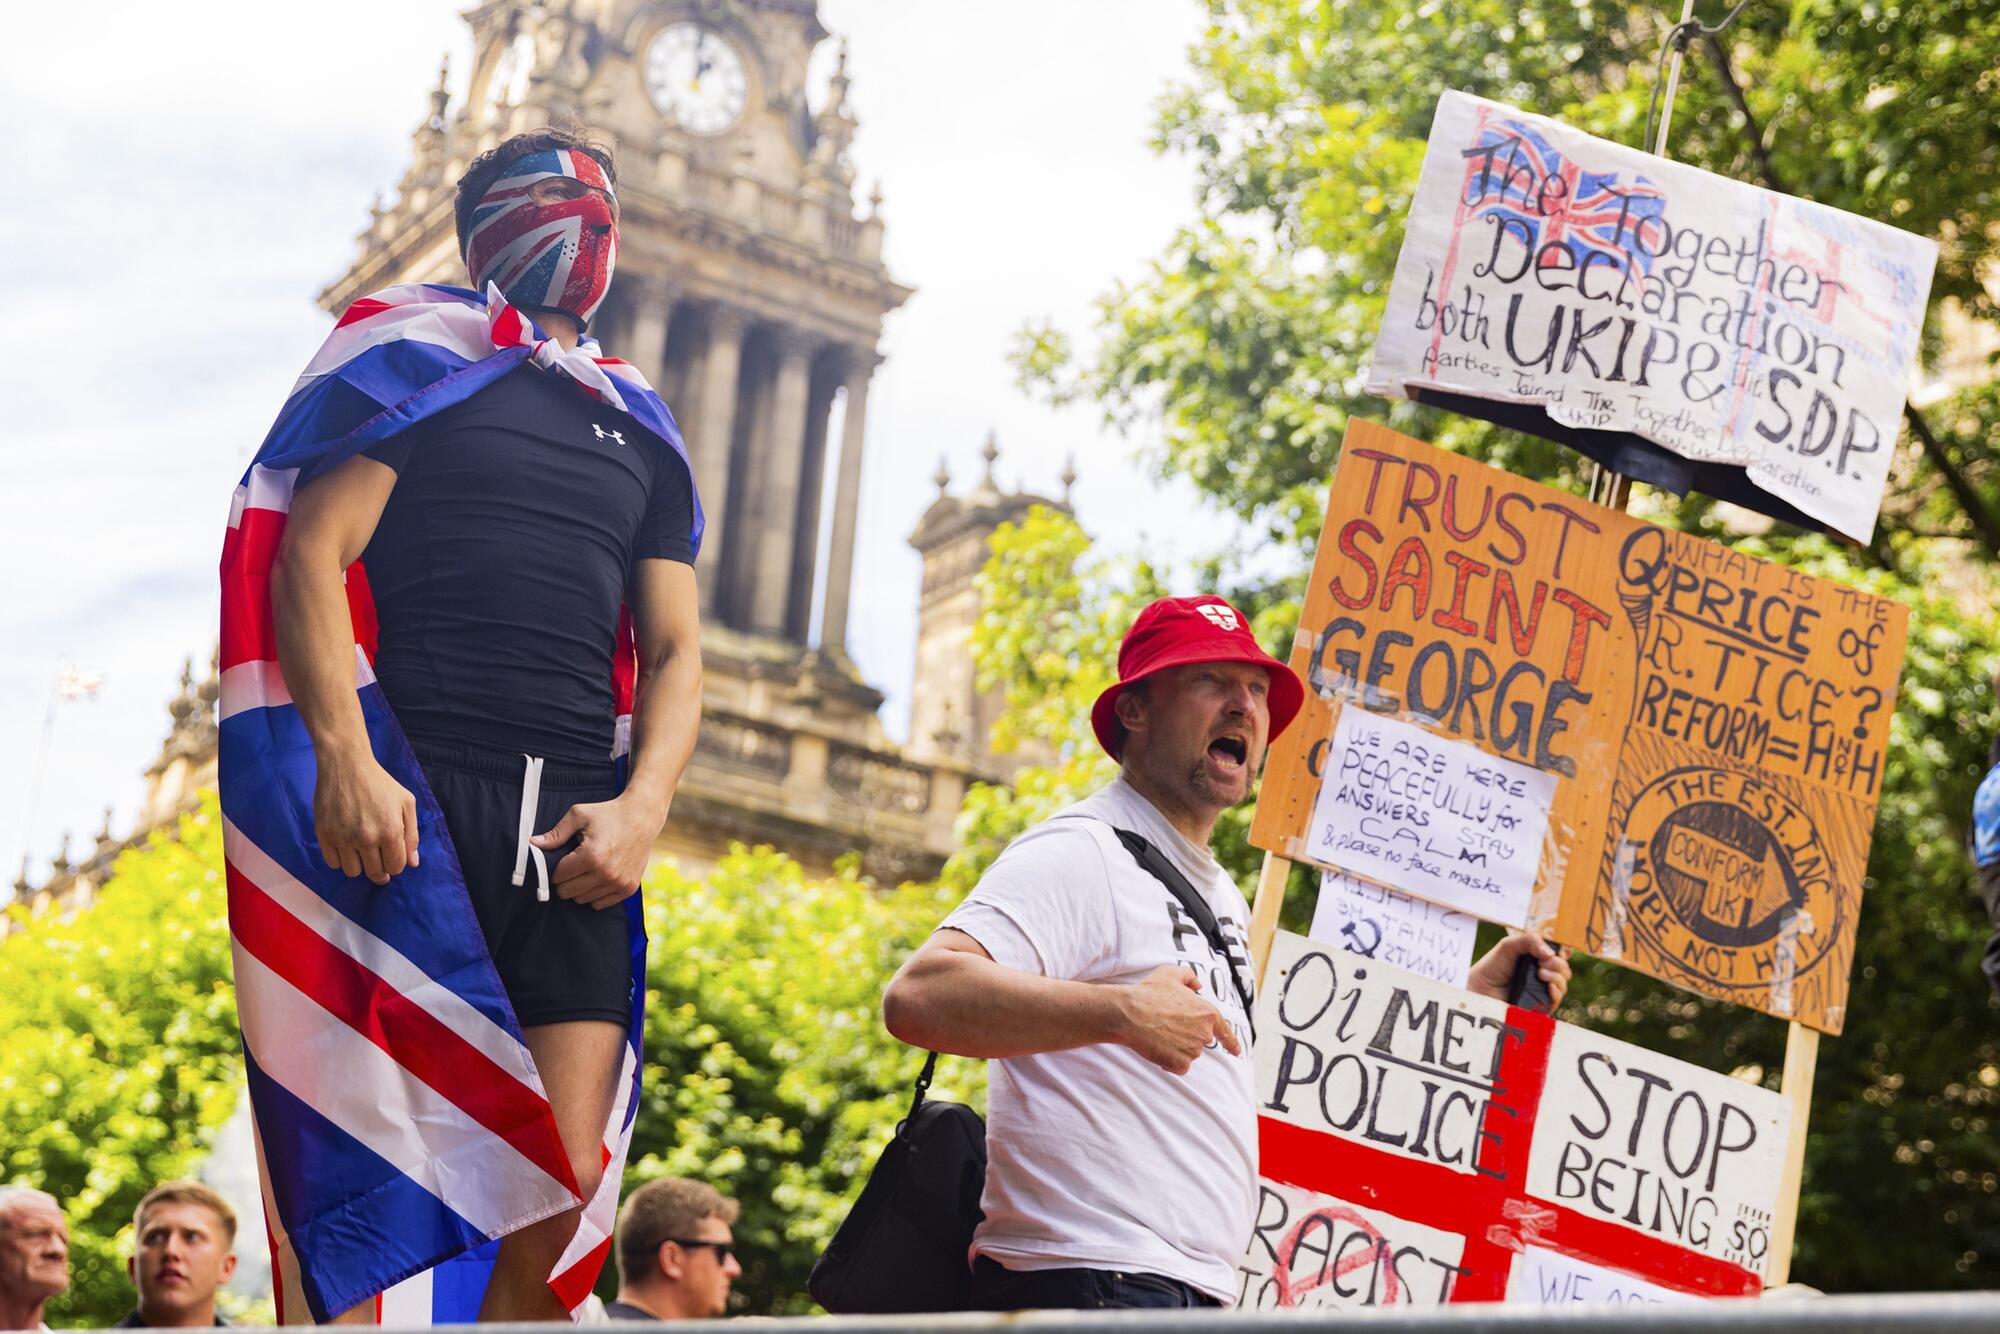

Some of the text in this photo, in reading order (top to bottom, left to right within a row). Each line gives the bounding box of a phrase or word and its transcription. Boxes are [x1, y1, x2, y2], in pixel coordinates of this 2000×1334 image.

[1461, 135, 1846, 309] The Together
[1473, 212, 1846, 388] Declaration
[1414, 263, 1490, 349] both
[1504, 293, 1678, 388] UKIP
[1680, 340, 1727, 410] &
[1755, 368, 1881, 481] S.D.P.
[1349, 446, 1601, 580] TRUST
[1328, 517, 1612, 686] SAINT
[1663, 564, 1885, 677] PRICE of
[1675, 531, 1770, 584] WHAT
[1780, 568, 1816, 600] IS
[1835, 587, 1895, 623] THE
[1308, 615, 1593, 779] GEORGE
[1645, 613, 1694, 679] R.
[1335, 785, 1515, 860] ANSWERS STAY
[1340, 747, 1491, 824] PEACEFULLY
[1488, 805, 1521, 833] for
[1349, 727, 1526, 798] WE ARE HERE
[1384, 849, 1402, 864] no
[1404, 854, 1442, 877] face
[1657, 773, 1832, 895] THE EST. INC
[1670, 831, 1764, 893] CONFORM
[1684, 940, 1737, 979] NOT
[1708, 885, 1741, 922] UK
[1278, 951, 1368, 1043] Oi
[1368, 987, 1526, 1083] MET
[1265, 1034, 1518, 1180] POLICE
[1570, 1051, 1757, 1193] STOP
[1245, 1185, 1472, 1306] RACIST
[1555, 1141, 1769, 1260] BEING SO
